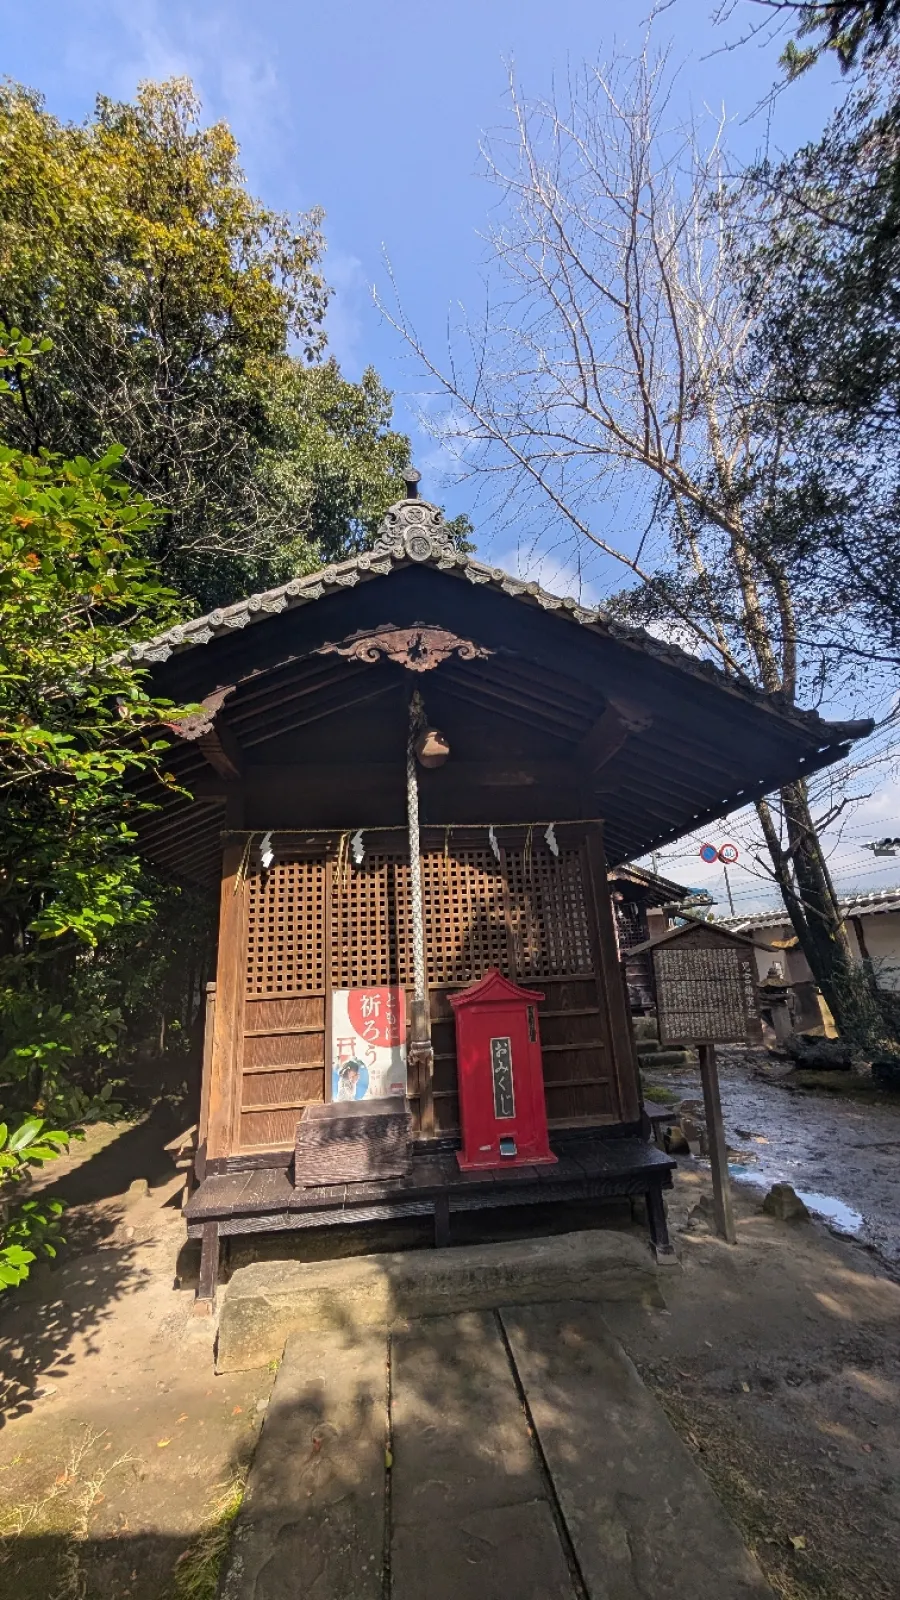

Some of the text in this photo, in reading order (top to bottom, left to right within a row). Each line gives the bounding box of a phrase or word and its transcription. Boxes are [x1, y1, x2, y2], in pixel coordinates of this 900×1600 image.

[360, 993, 381, 1068] 祈ろう
[385, 992, 399, 1041] ともに
[494, 1041, 511, 1115] おみくじ
